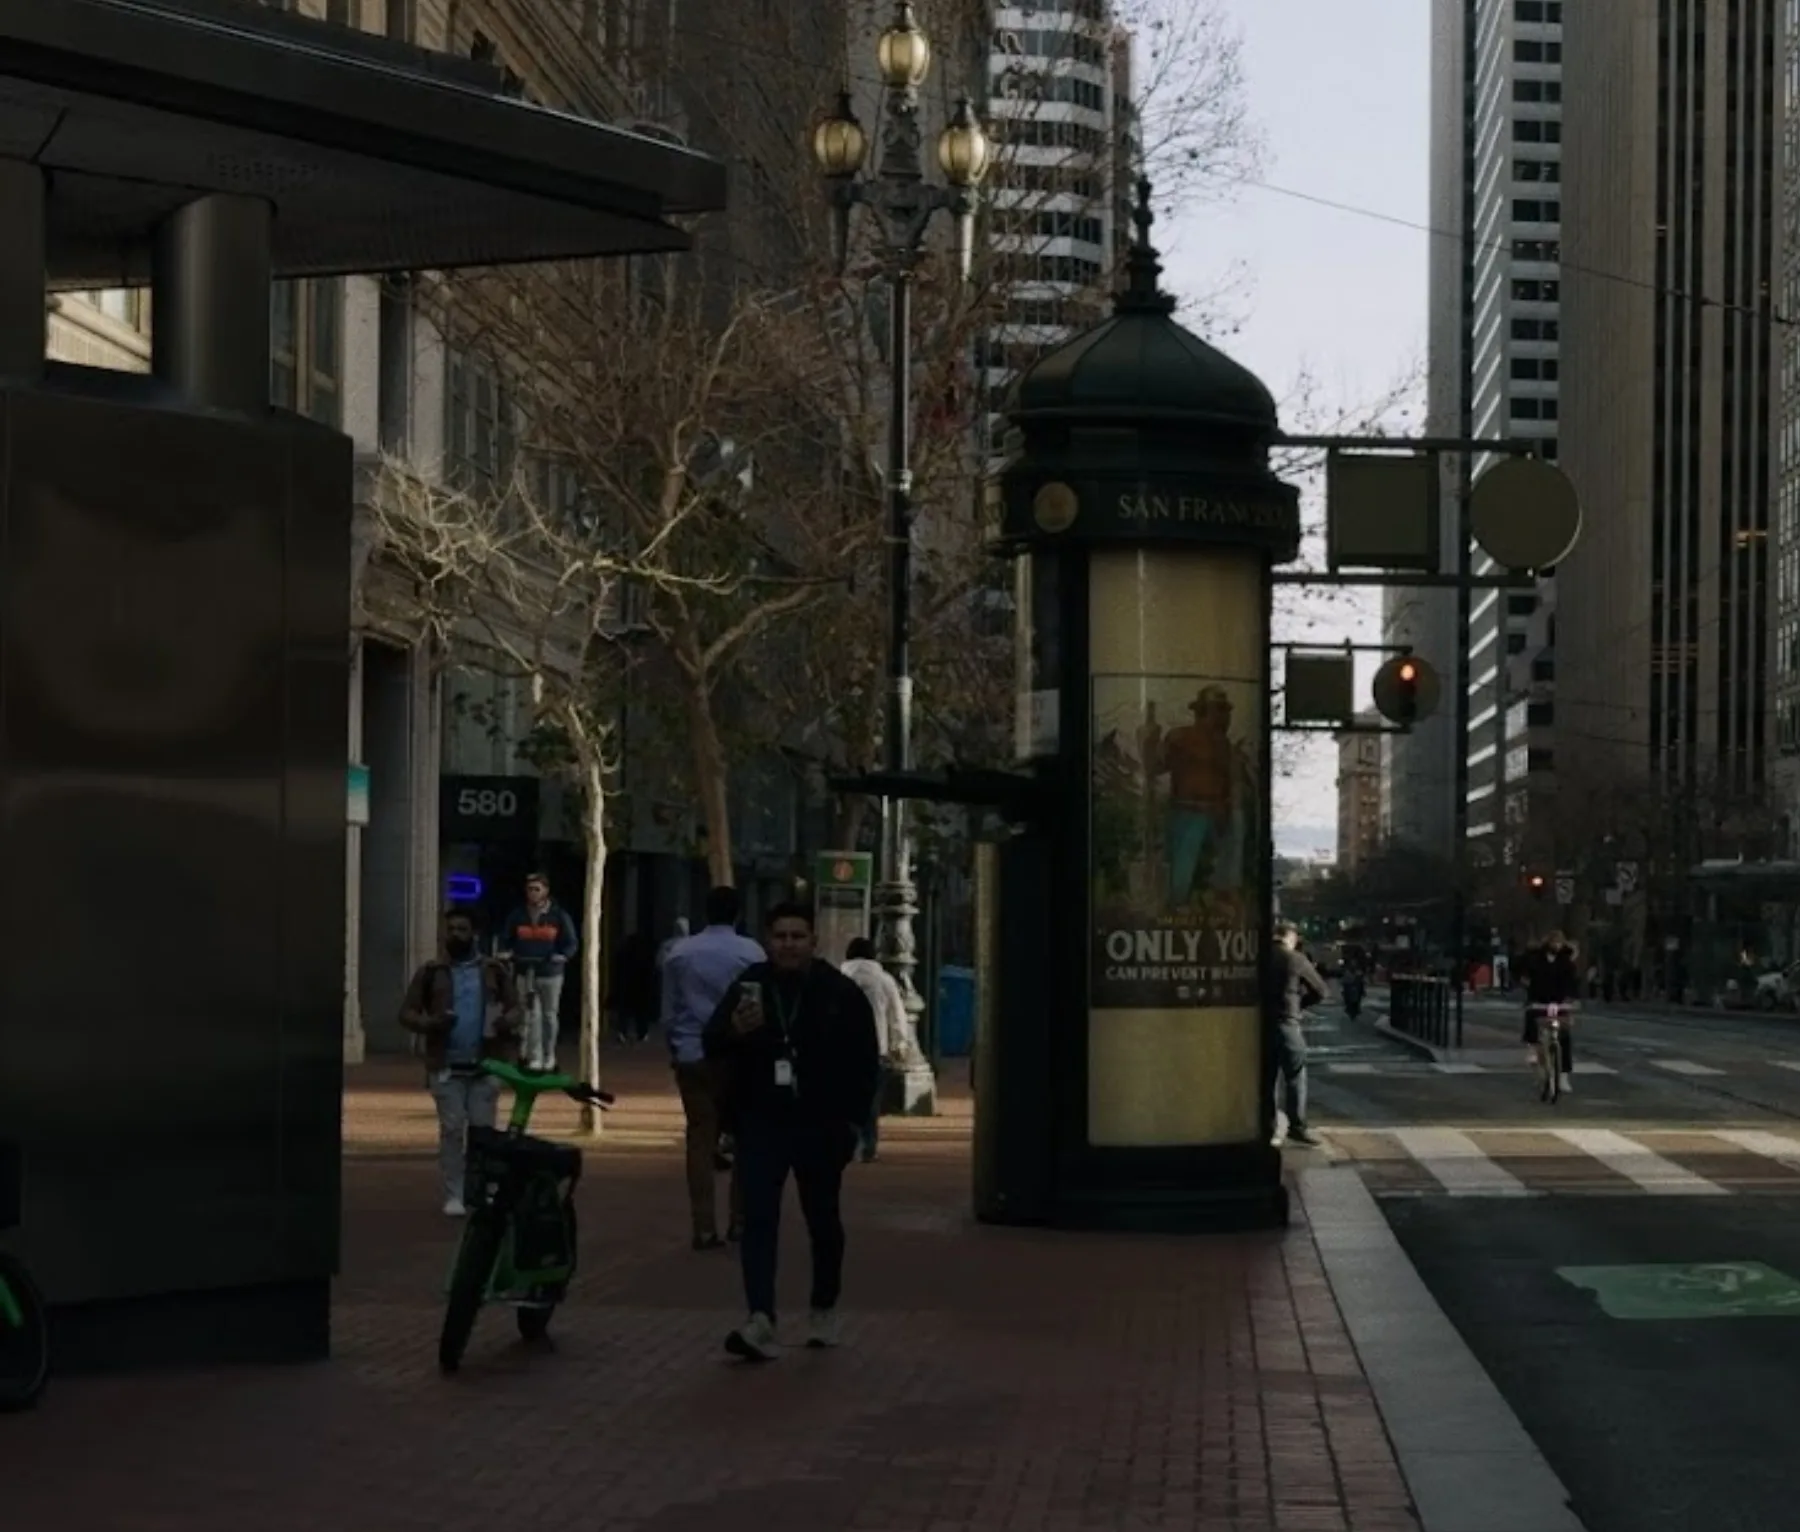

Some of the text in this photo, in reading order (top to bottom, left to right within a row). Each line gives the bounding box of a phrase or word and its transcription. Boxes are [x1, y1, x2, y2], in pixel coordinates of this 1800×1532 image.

[1117, 493, 1169, 520] SAN
[457, 787, 518, 817] 580
[1215, 929, 1260, 963] YOU
[1104, 965, 1139, 981] CAN
[1140, 965, 1207, 981] PREVENT
